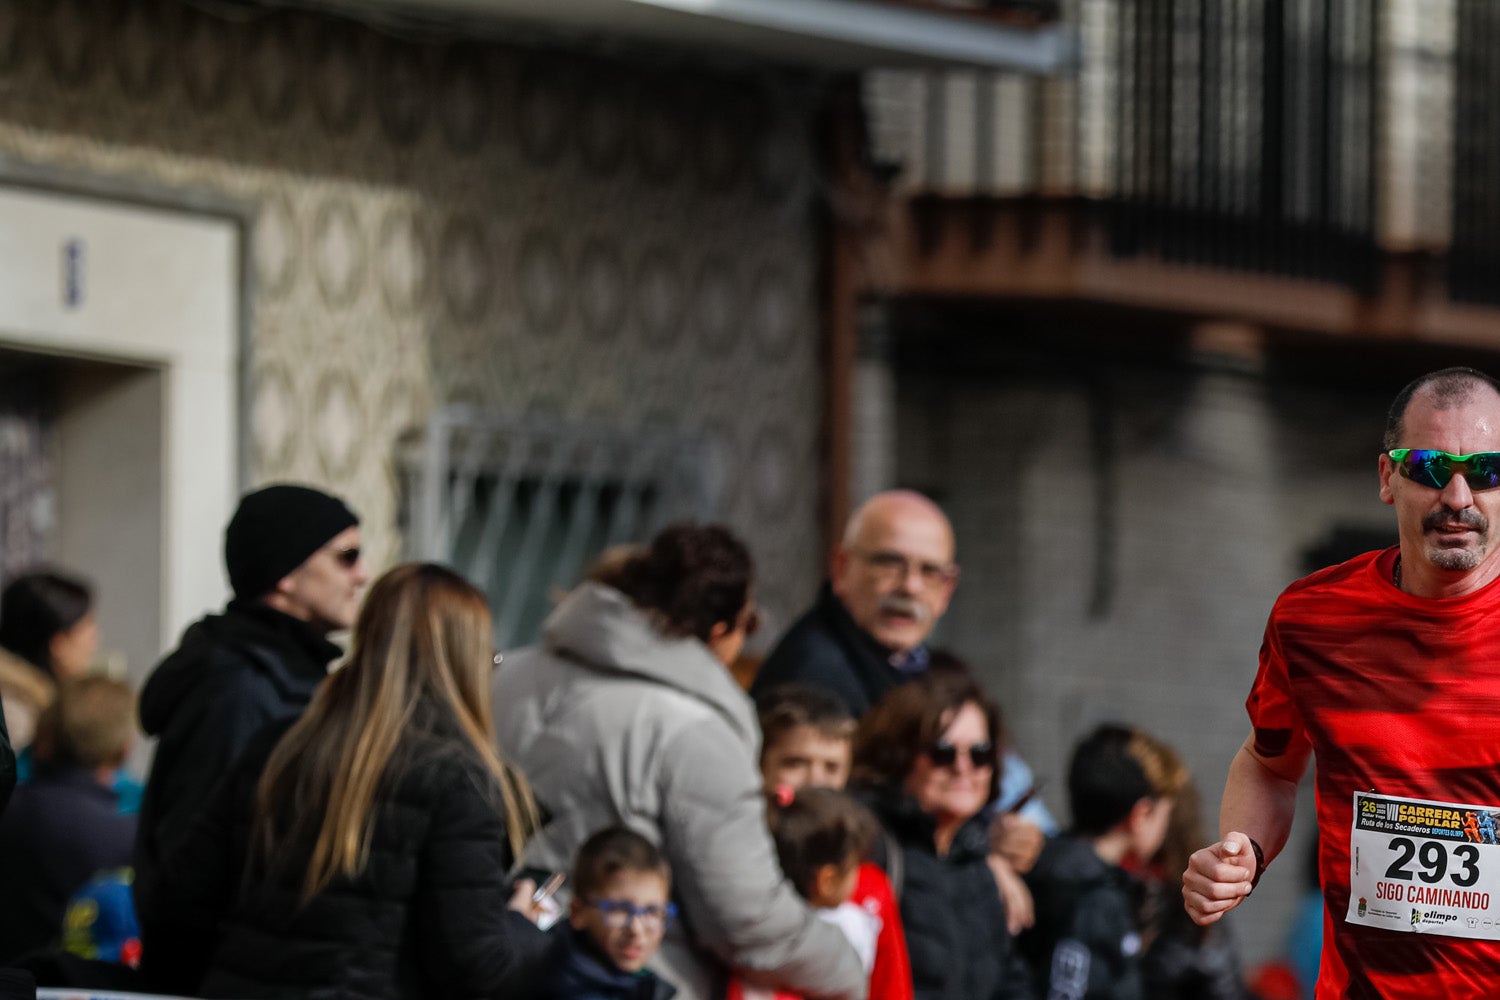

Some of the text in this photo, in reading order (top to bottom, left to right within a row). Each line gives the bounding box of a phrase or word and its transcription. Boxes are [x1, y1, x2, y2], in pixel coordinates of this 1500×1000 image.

[1362, 801, 1376, 813] 26
[1399, 804, 1460, 821] CARRERA
[1361, 818, 1375, 827] Ruta
[1384, 821, 1393, 829] los
[1395, 822, 1431, 834] Secaderos
[1398, 815, 1460, 829] POPULAR
[1385, 837, 1480, 887] 293
[1376, 881, 1490, 910] SIGO CAMINANDO
[1424, 911, 1458, 922] olimpo
